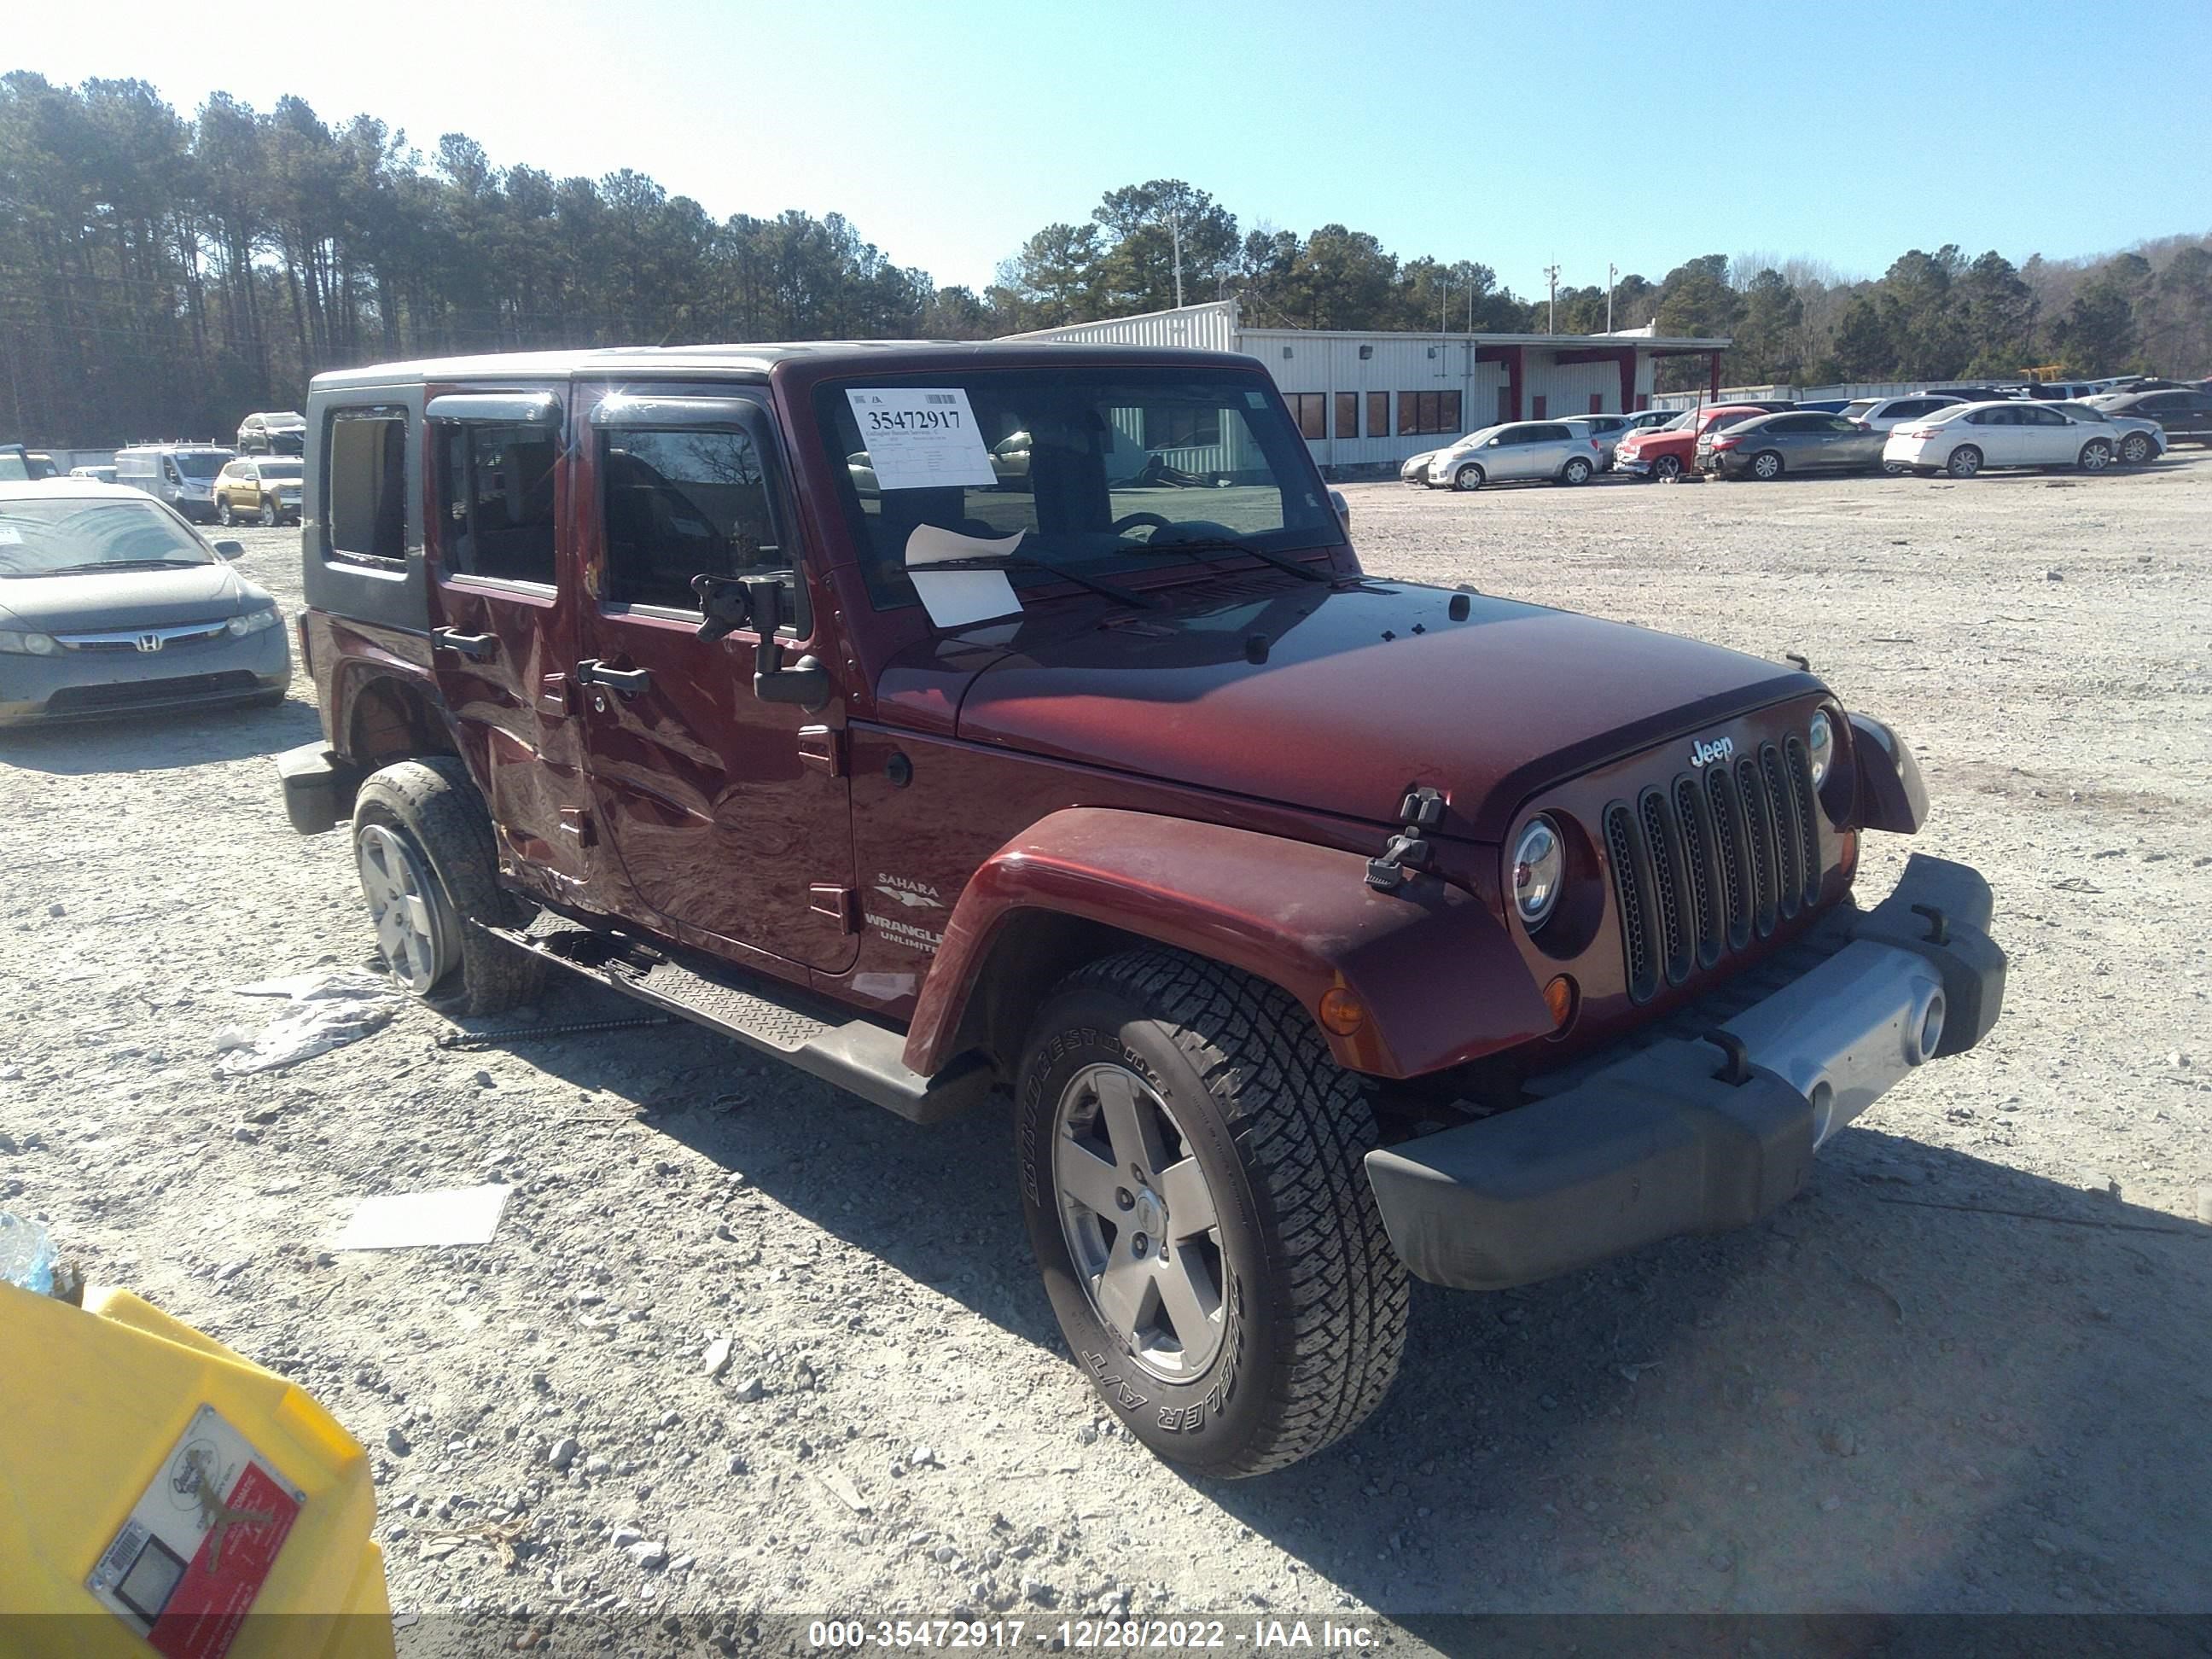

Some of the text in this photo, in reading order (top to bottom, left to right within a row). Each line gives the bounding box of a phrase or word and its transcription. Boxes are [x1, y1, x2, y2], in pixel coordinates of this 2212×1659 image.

[868, 410, 960, 430] 35472917
[1691, 736, 1733, 767] Jeep
[878, 872, 940, 898] SAHARA
[864, 912, 944, 944] WRANGLE
